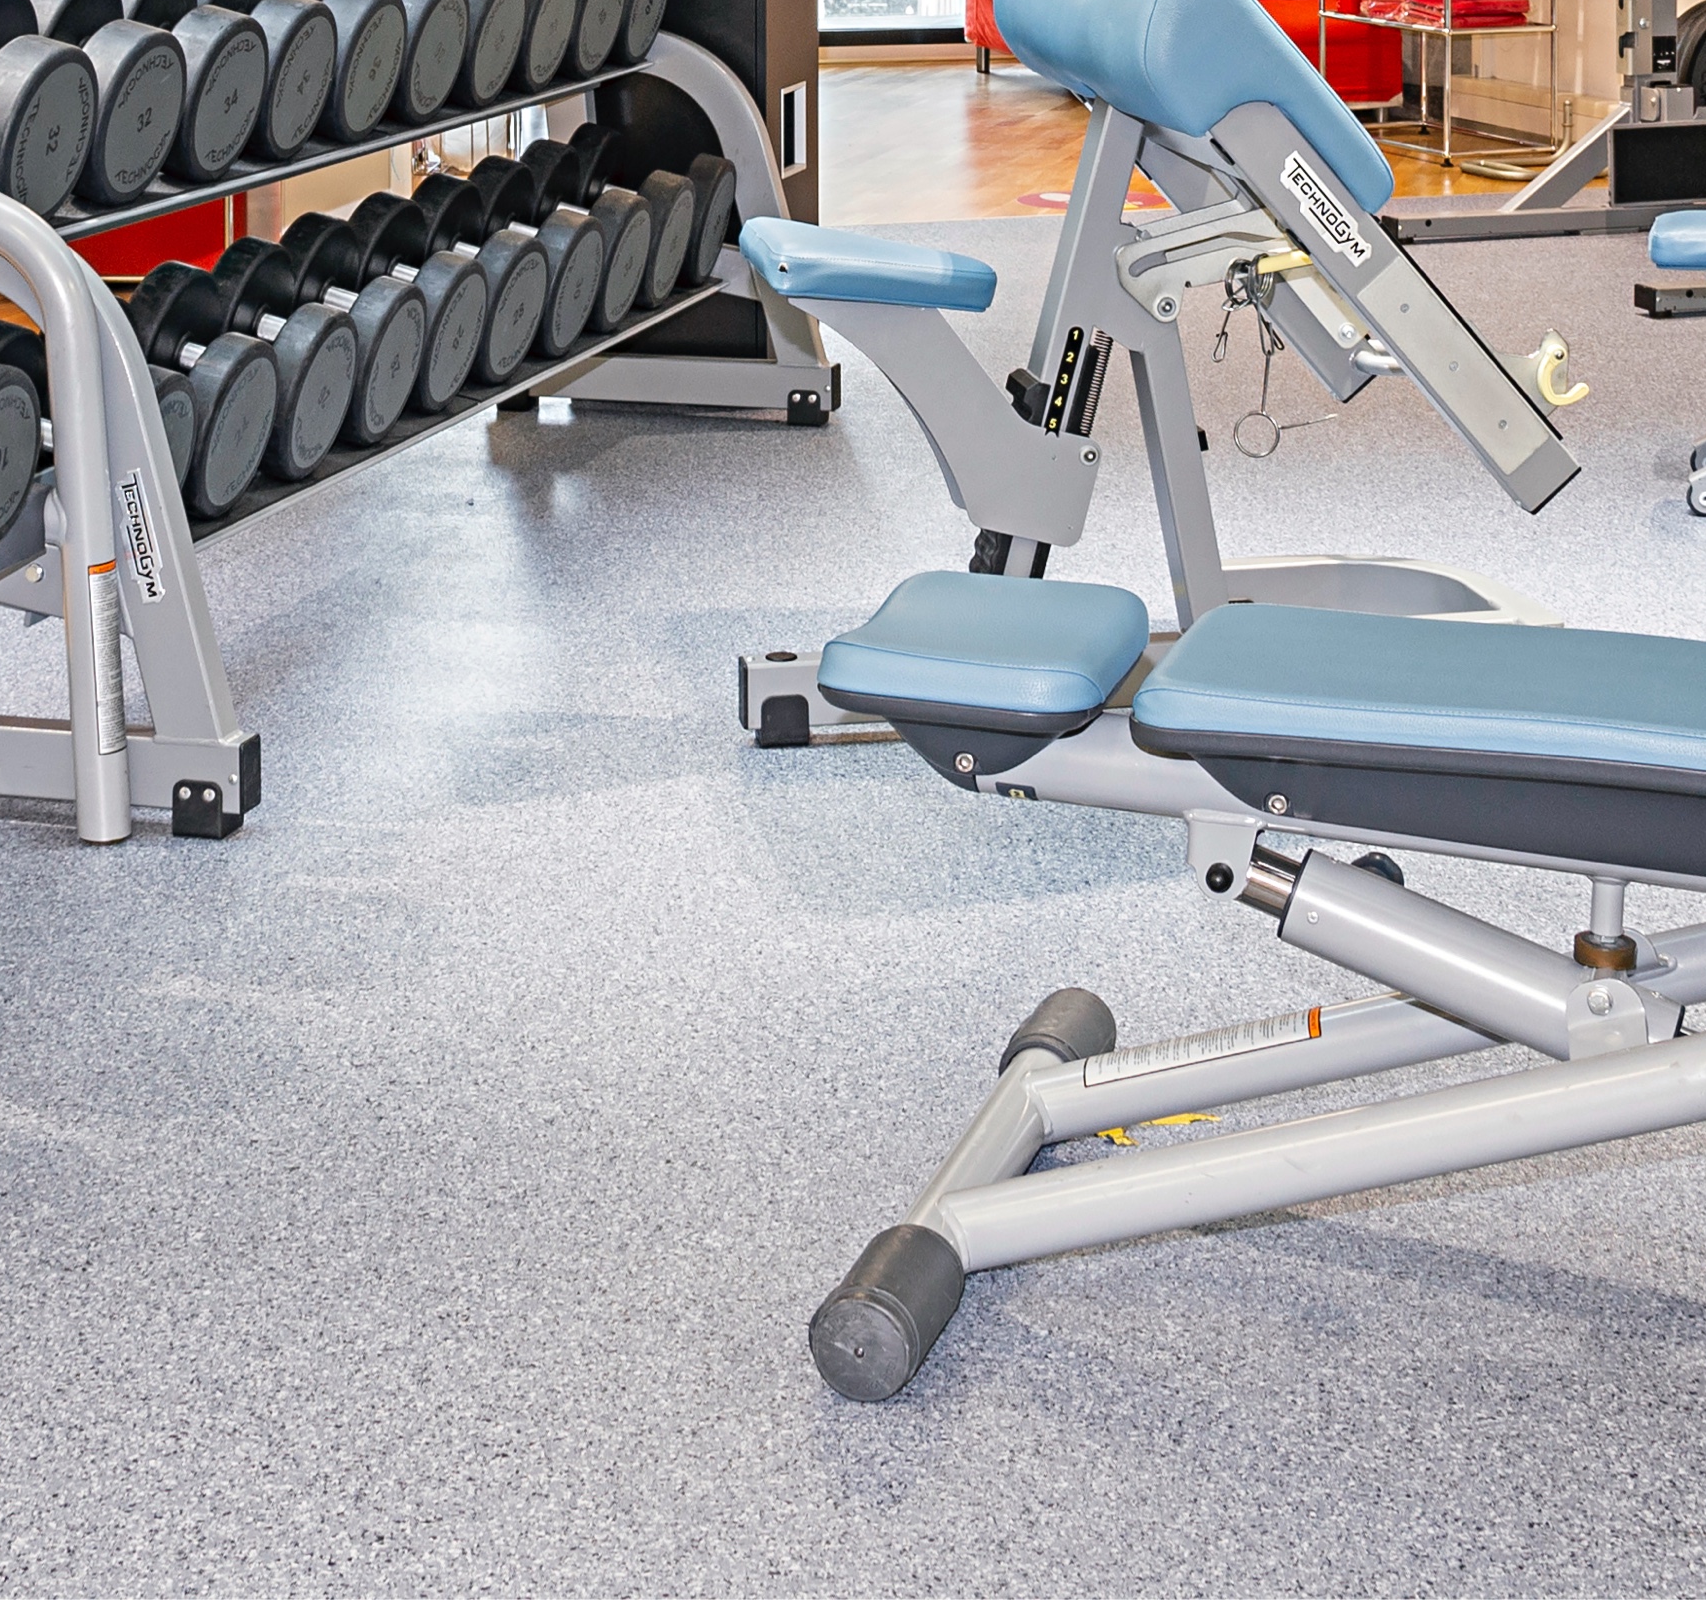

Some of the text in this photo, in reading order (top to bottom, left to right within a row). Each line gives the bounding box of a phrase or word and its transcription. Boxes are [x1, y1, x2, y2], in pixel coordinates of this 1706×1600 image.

[205, 39, 257, 96] TECHNOGYM
[276, 24, 316, 108] TECHNOGYM
[348, 14, 384, 99] TECHNOGYM
[117, 54, 174, 109] TECHNOGYM
[224, 88, 238, 114] 34
[45, 125, 60, 156] 32
[65, 77, 91, 183] TECHNOGYM
[136, 107, 152, 133] 32
[114, 130, 171, 185] TECHNOGYM
[1287, 157, 1366, 258] TECHNOGYM
[1073, 330, 1079, 340] 1
[1066, 352, 1075, 362] 2
[1060, 373, 1068, 385] 3
[1054, 396, 1063, 407] 4
[1048, 418, 1057, 429] 5
[122, 473, 158, 598] TECHNOGYM
